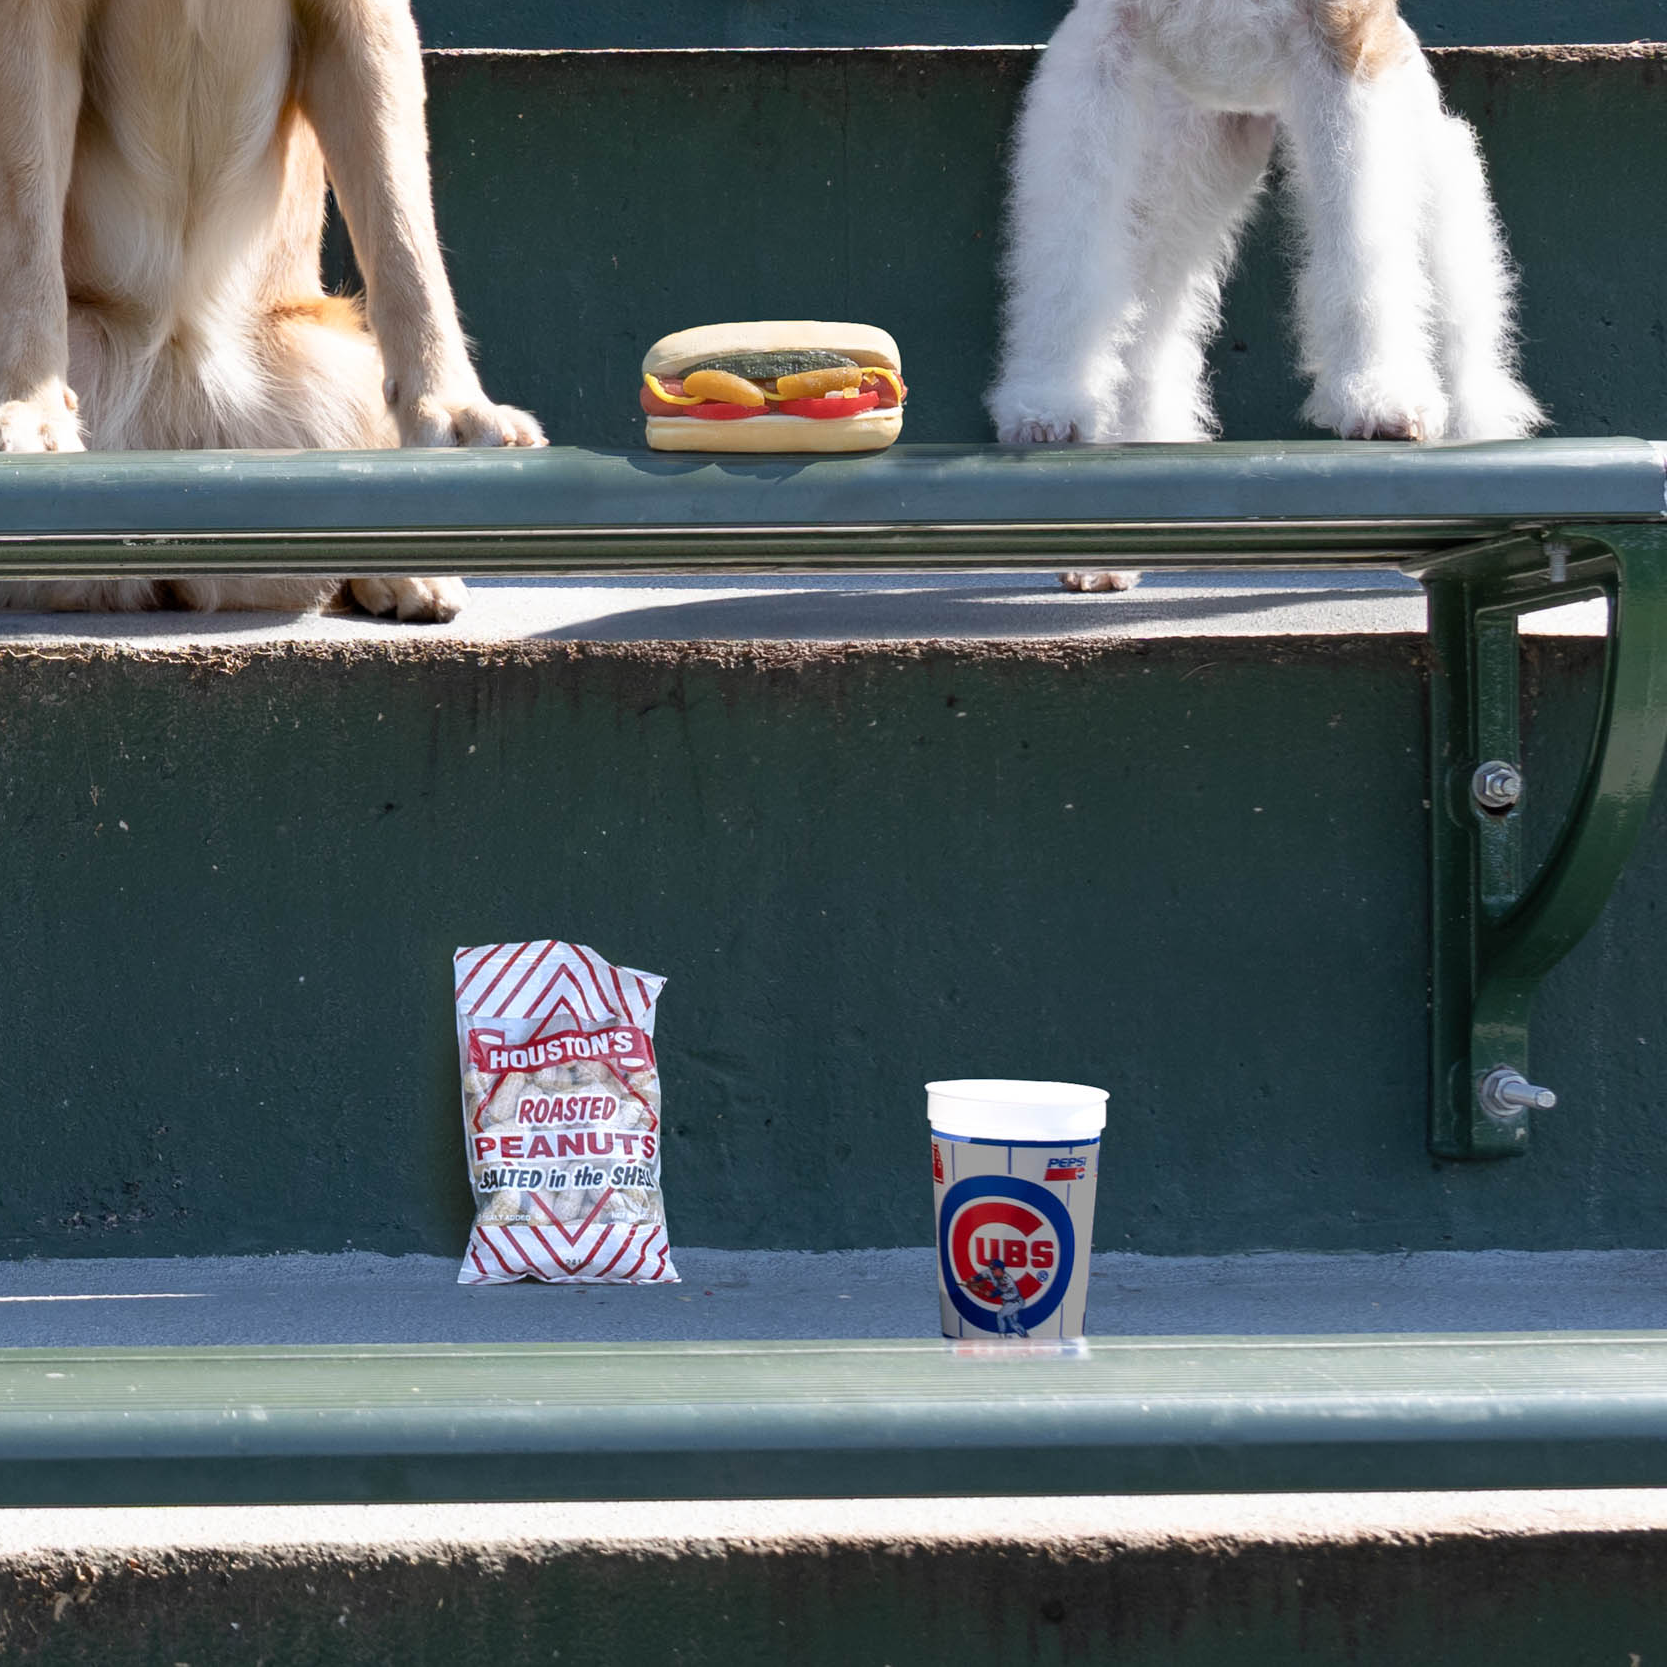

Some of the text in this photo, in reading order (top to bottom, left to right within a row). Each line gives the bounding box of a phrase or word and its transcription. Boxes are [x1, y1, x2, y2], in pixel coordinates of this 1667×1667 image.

[489, 1032, 633, 1069] HOUSTON'S
[518, 1096, 616, 1124] ROASTED
[474, 1132, 656, 1161] PEANUTS
[480, 1169, 542, 1189] SALTED
[549, 1169, 566, 1188] in
[574, 1164, 603, 1187] the
